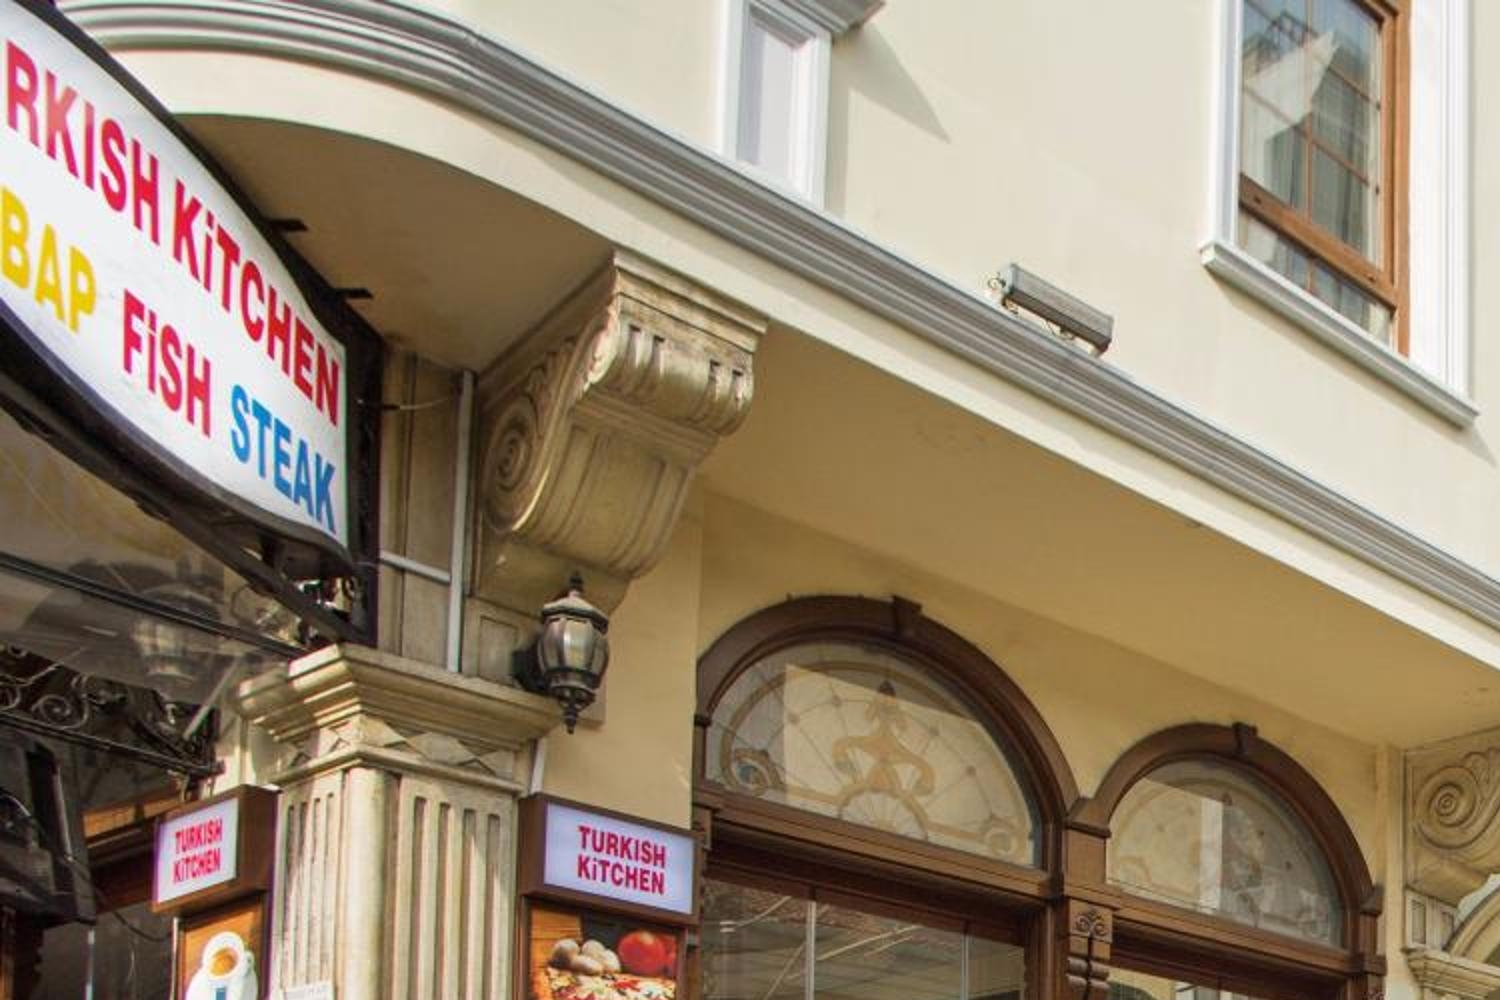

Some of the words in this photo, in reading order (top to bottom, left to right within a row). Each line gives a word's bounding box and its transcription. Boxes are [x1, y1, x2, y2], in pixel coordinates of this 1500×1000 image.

[6, 39, 160, 247] RKISH
[0, 185, 97, 335] BAP
[230, 384, 337, 534] STEAK
[175, 818, 223, 856] TURKISH
[578, 825, 666, 869] TURKISH
